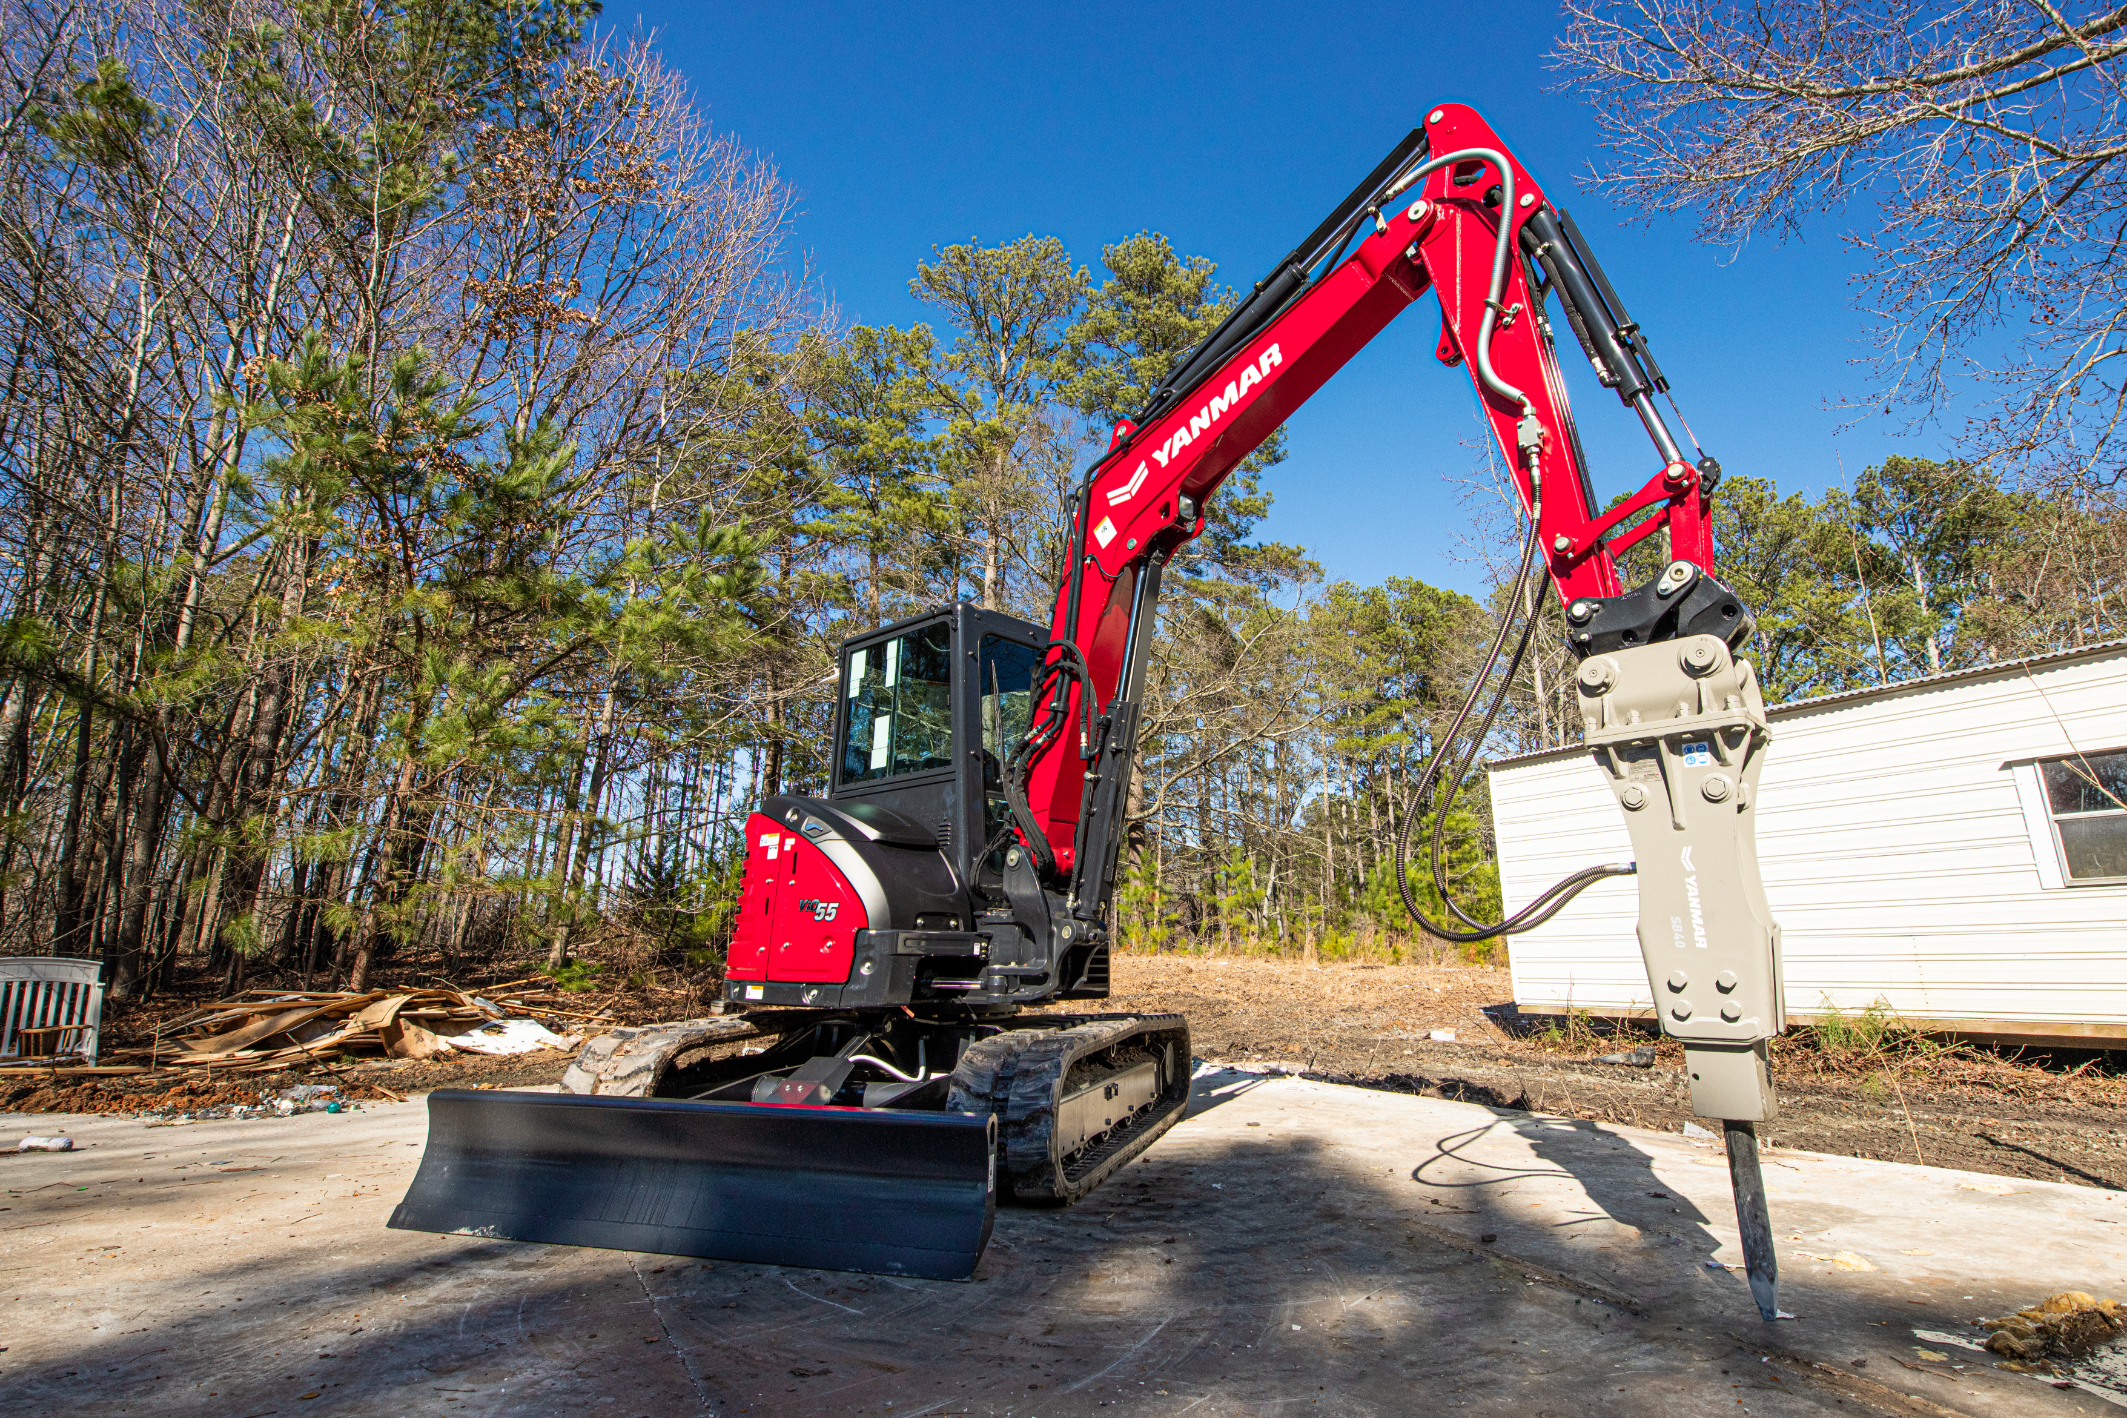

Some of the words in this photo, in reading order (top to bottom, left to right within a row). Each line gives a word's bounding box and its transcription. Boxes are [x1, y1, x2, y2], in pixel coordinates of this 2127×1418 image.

[1151, 342, 1283, 468] YANMAR
[1670, 915, 1686, 949] SB40
[1684, 874, 1708, 949] YANMAR
